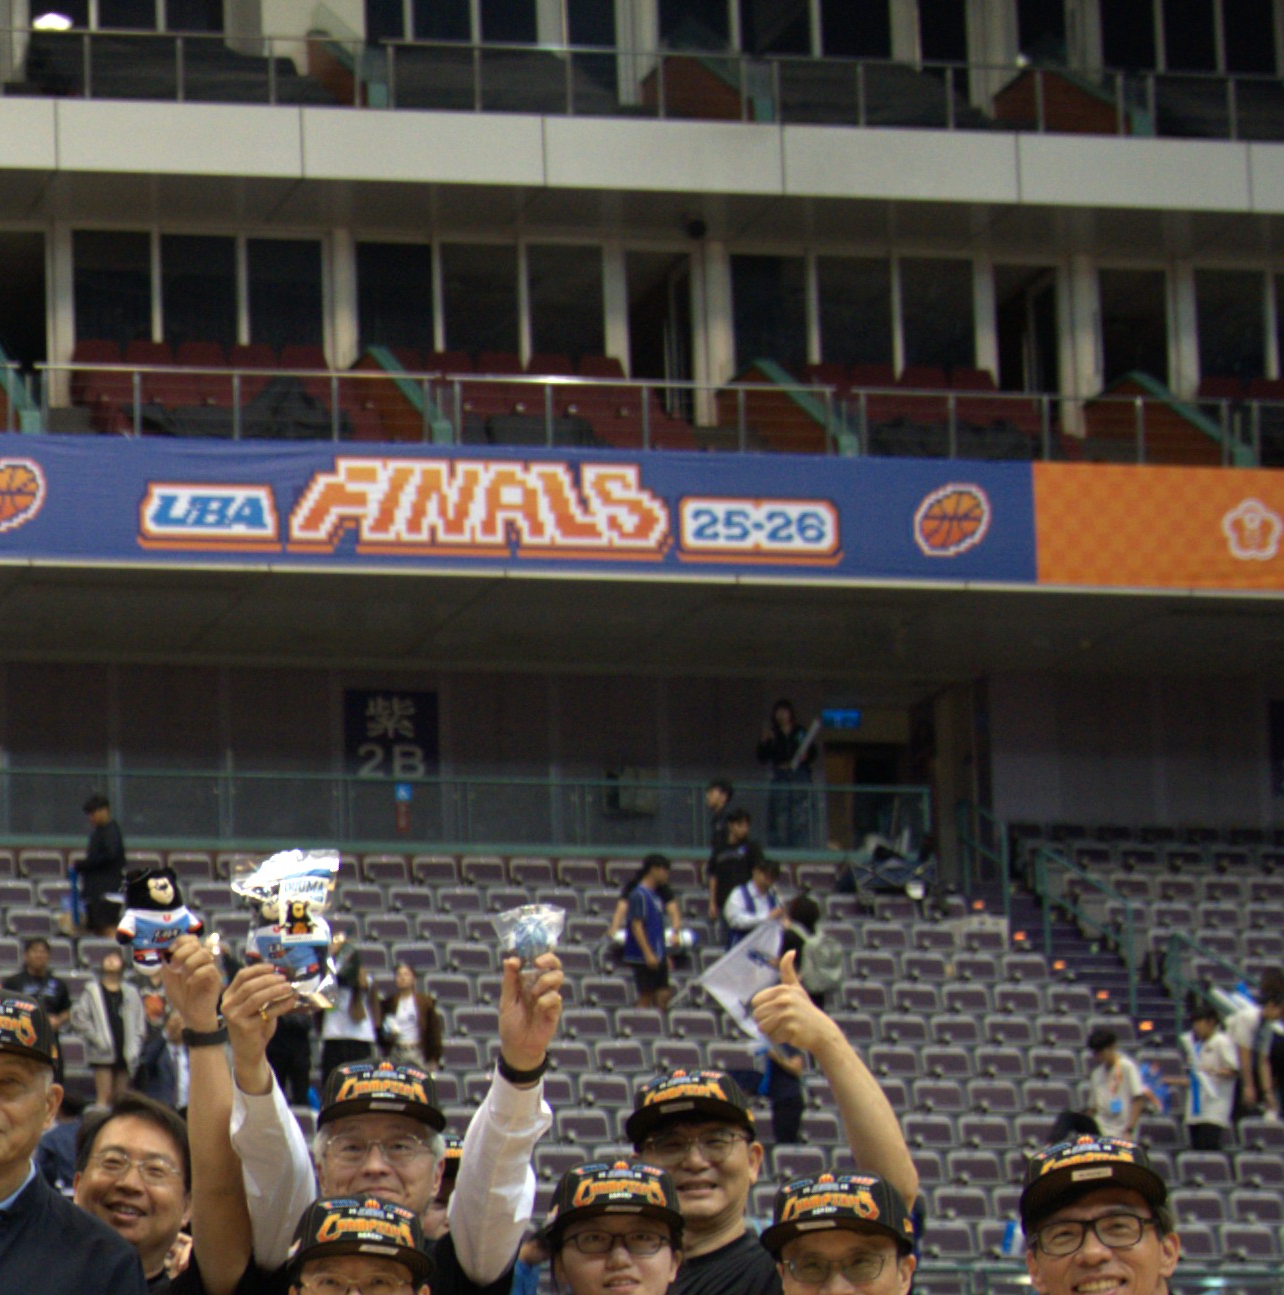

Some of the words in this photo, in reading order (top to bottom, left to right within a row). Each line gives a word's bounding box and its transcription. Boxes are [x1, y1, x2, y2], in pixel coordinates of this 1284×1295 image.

[291, 462, 669, 547] FINALS
[691, 508, 828, 546] 25-26
[357, 743, 426, 779] 2B
